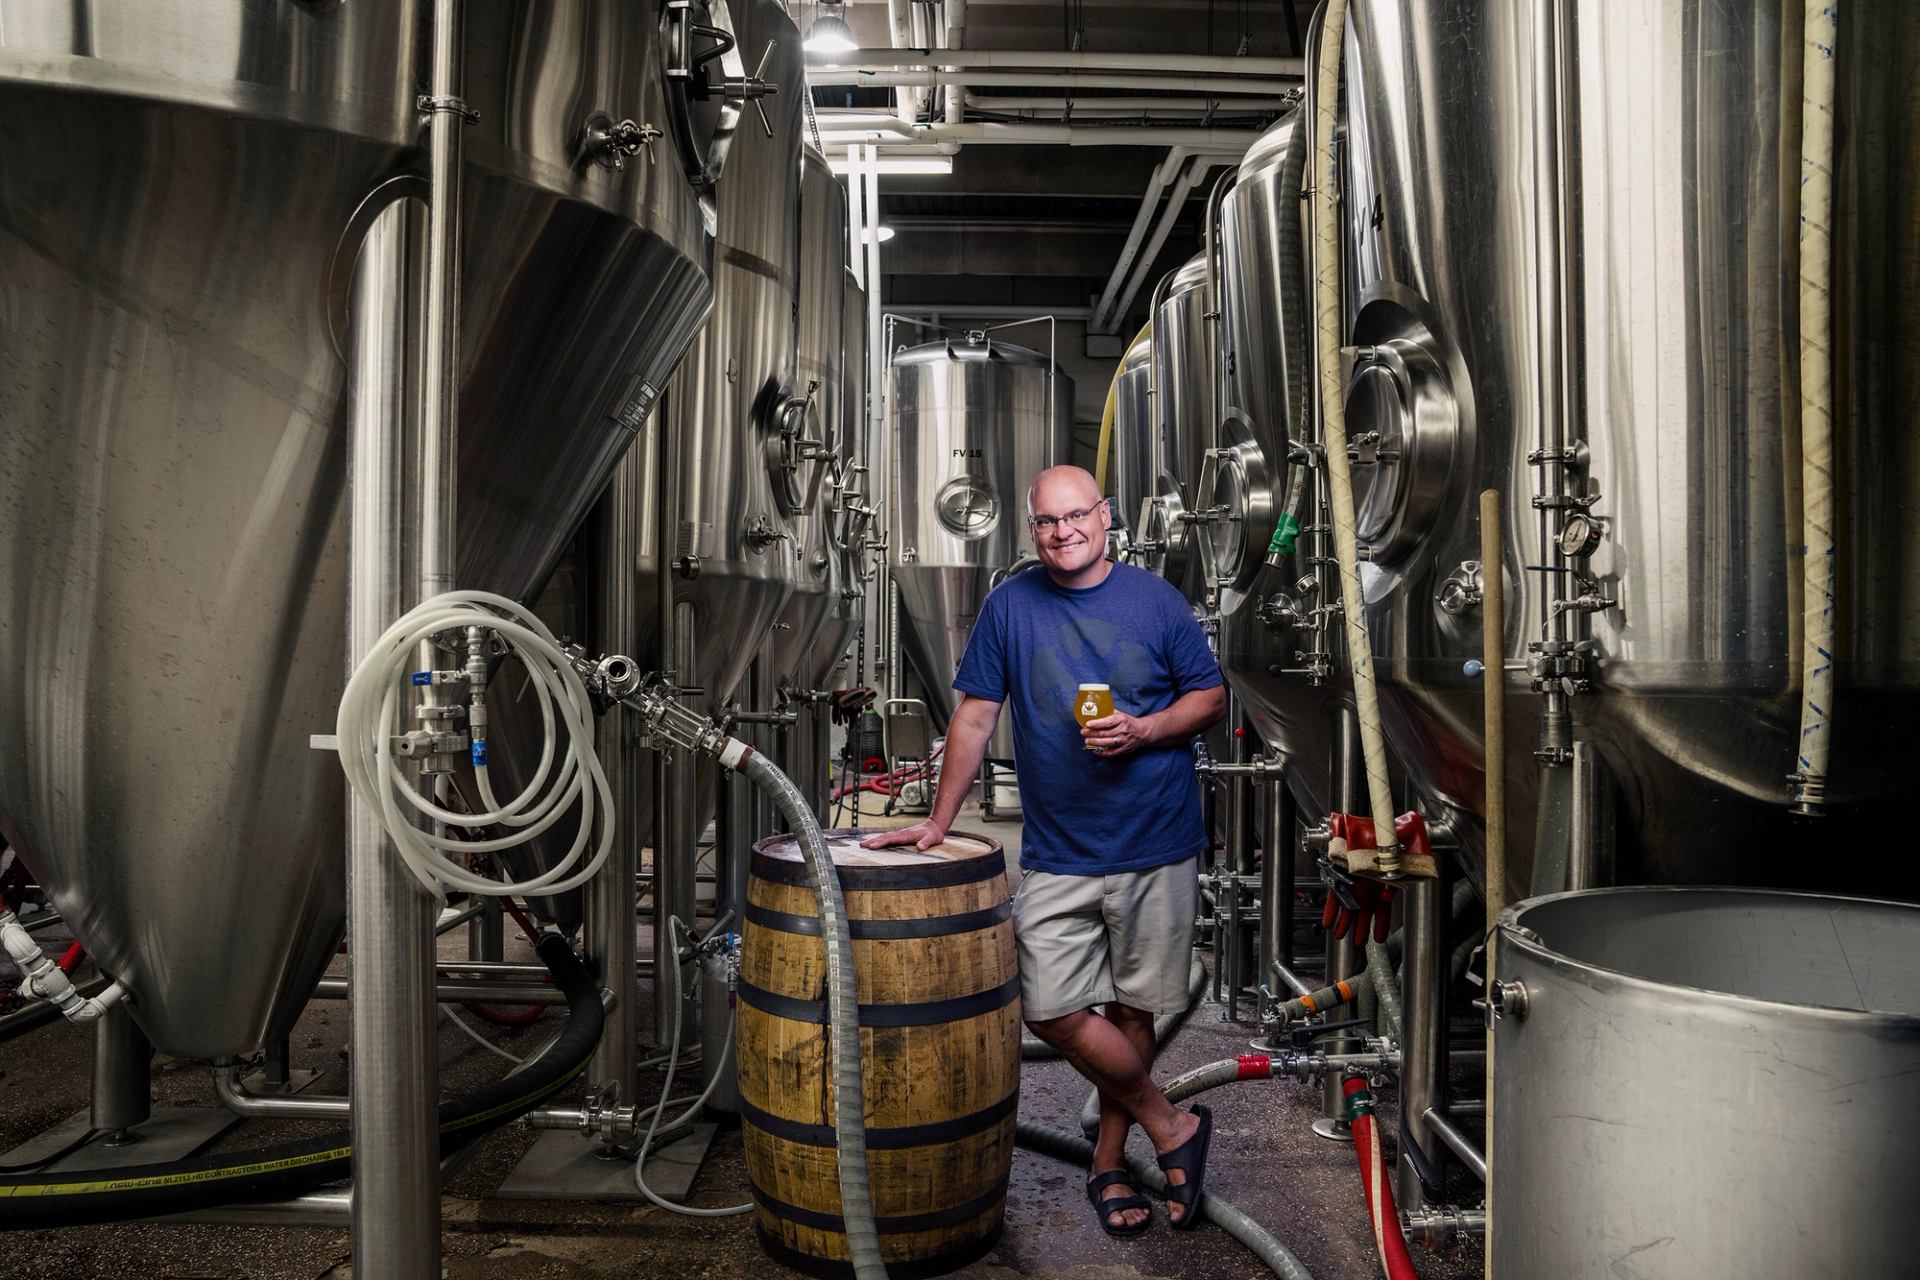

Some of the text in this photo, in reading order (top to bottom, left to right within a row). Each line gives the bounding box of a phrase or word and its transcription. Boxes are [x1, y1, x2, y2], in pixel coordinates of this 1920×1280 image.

[953, 449, 982, 458] FV 15
[192, 1172, 204, 1181] HD
[205, 1165, 262, 1179] CONTRACTORS
[263, 1160, 289, 1170] WATER
[290, 1152, 332, 1165] DISCHARGE
